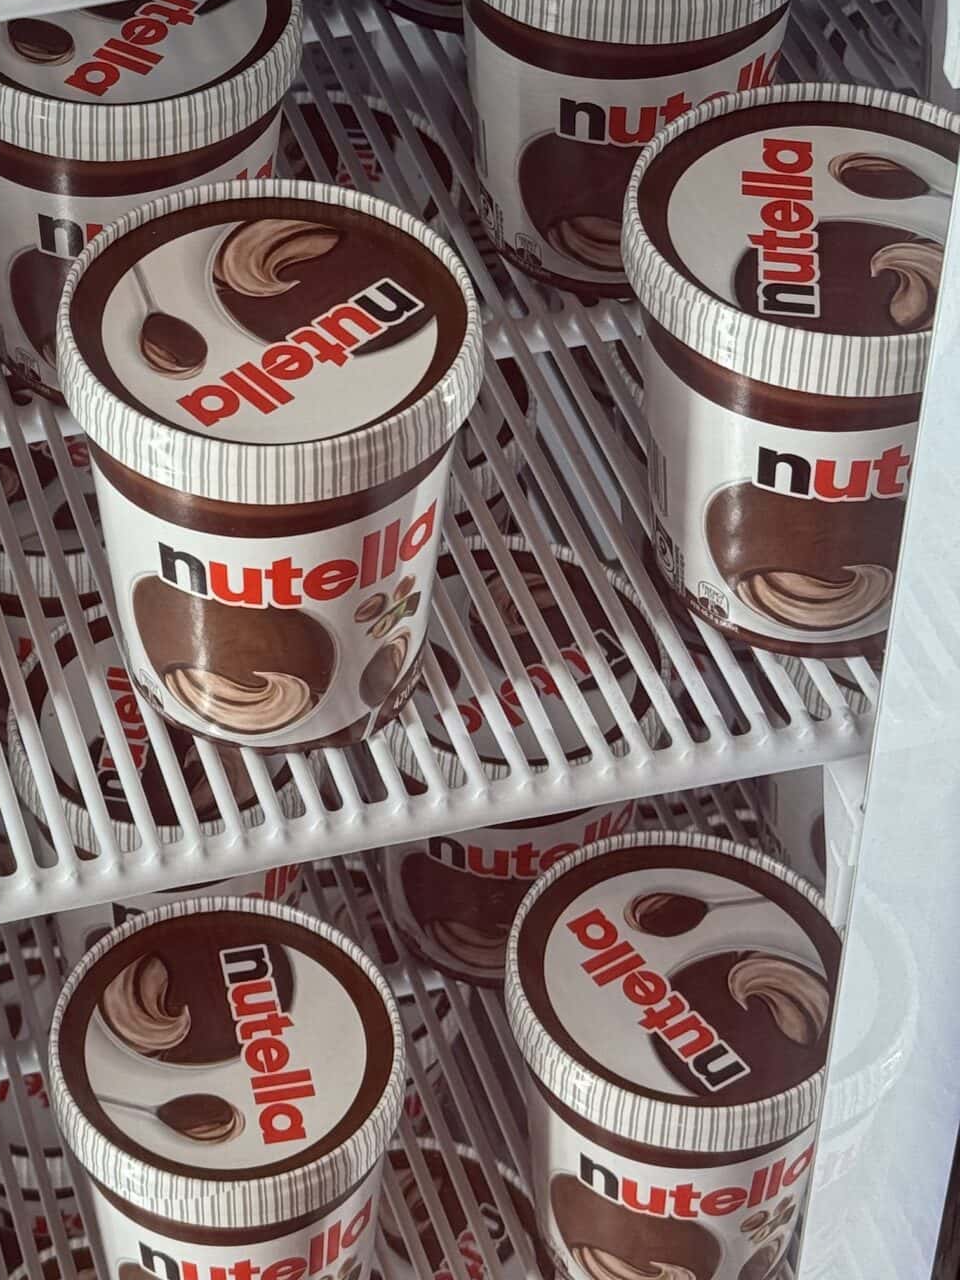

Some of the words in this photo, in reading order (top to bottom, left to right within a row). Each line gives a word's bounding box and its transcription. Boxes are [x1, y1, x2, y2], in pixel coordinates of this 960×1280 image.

[741, 138, 818, 316] nutella
[176, 280, 422, 427] nutella
[159, 498, 438, 607] nutella
[222, 946, 316, 1145] nutella
[567, 908, 748, 1089] nutella
